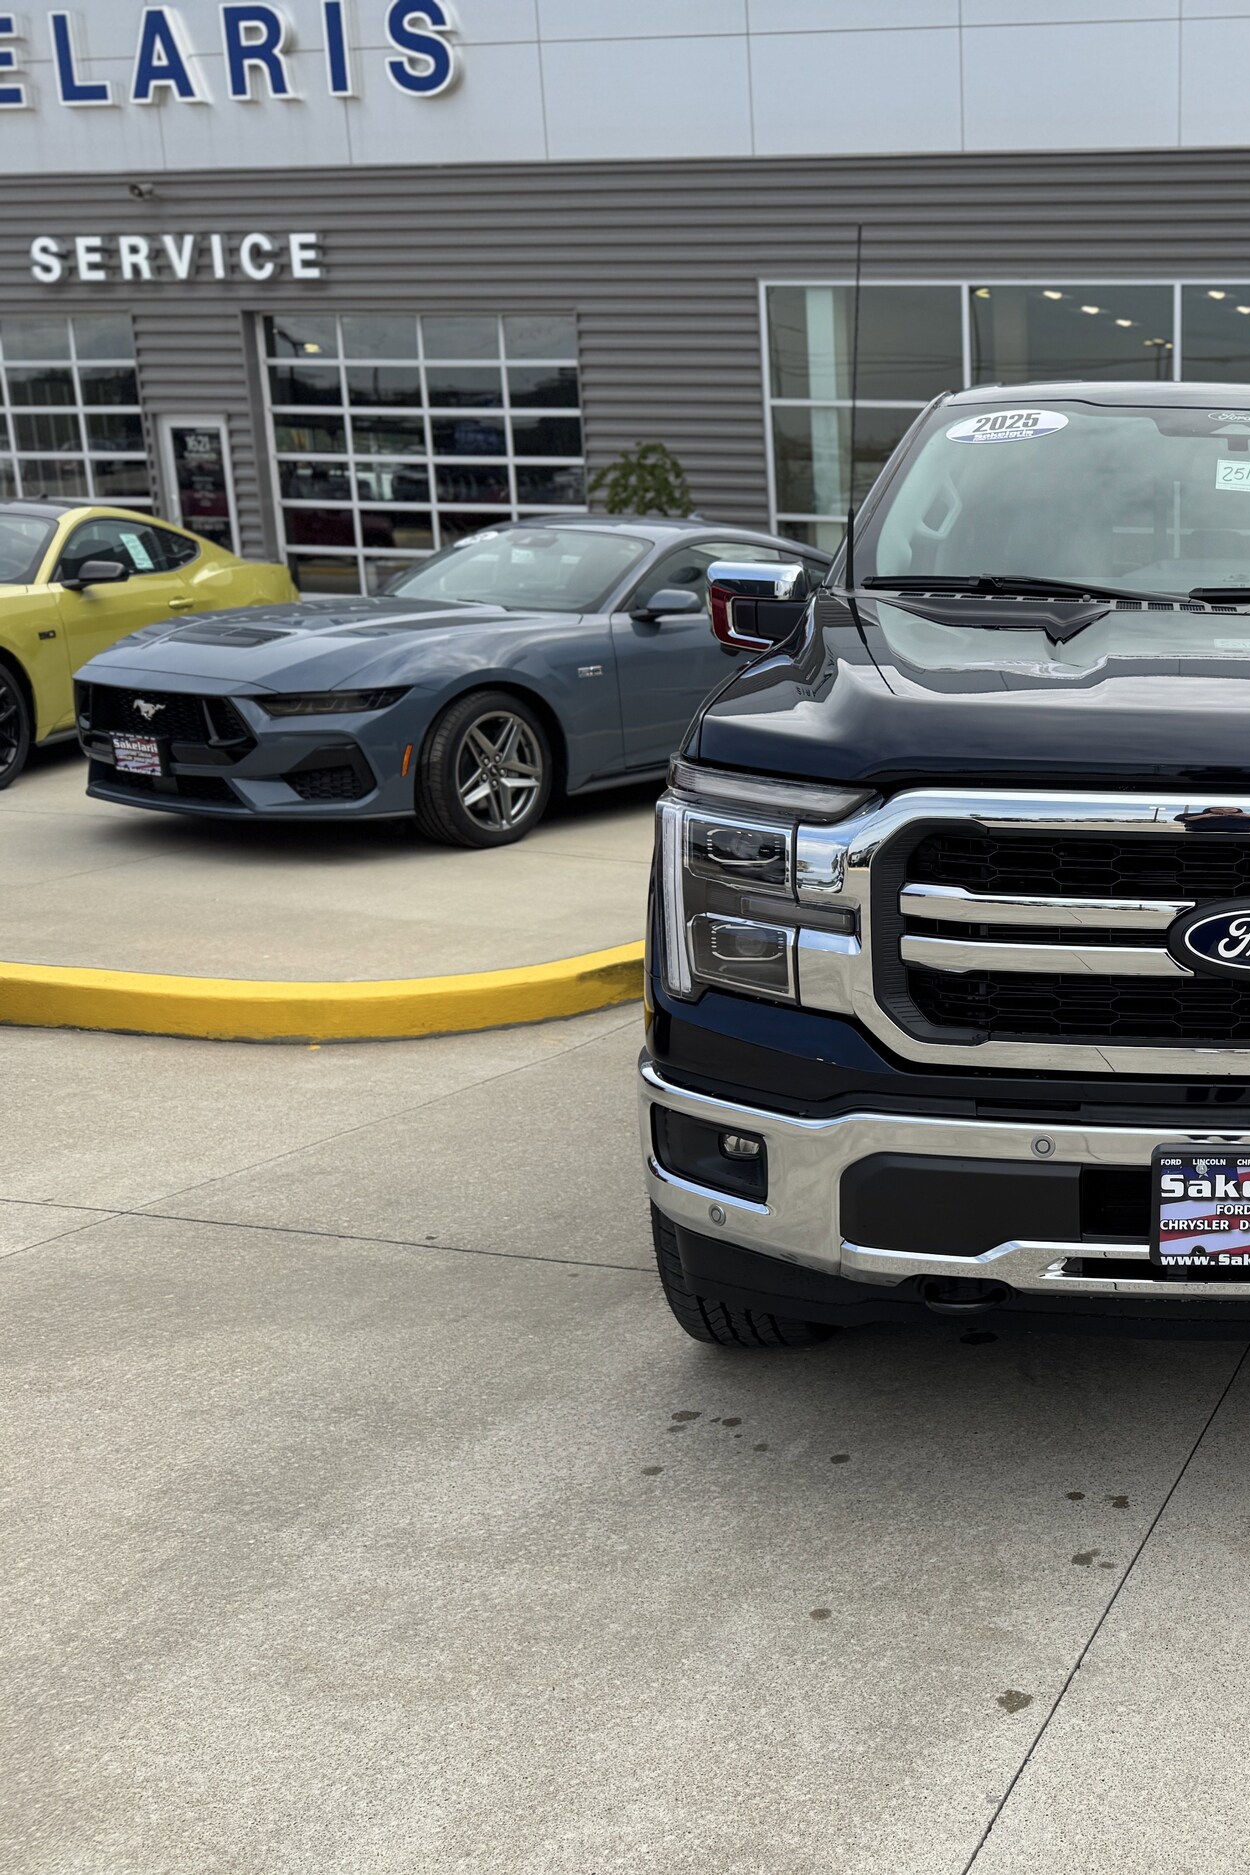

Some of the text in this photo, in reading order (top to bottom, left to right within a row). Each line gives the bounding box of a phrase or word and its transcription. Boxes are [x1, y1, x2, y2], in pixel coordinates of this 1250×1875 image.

[30, 233, 321, 283] SERVICE
[972, 412, 1042, 433] 2025
[1160, 1158, 1182, 1166] FORD
[1192, 1158, 1227, 1166] LINCOLN
[1160, 1219, 1230, 1231] CHRYSLER
